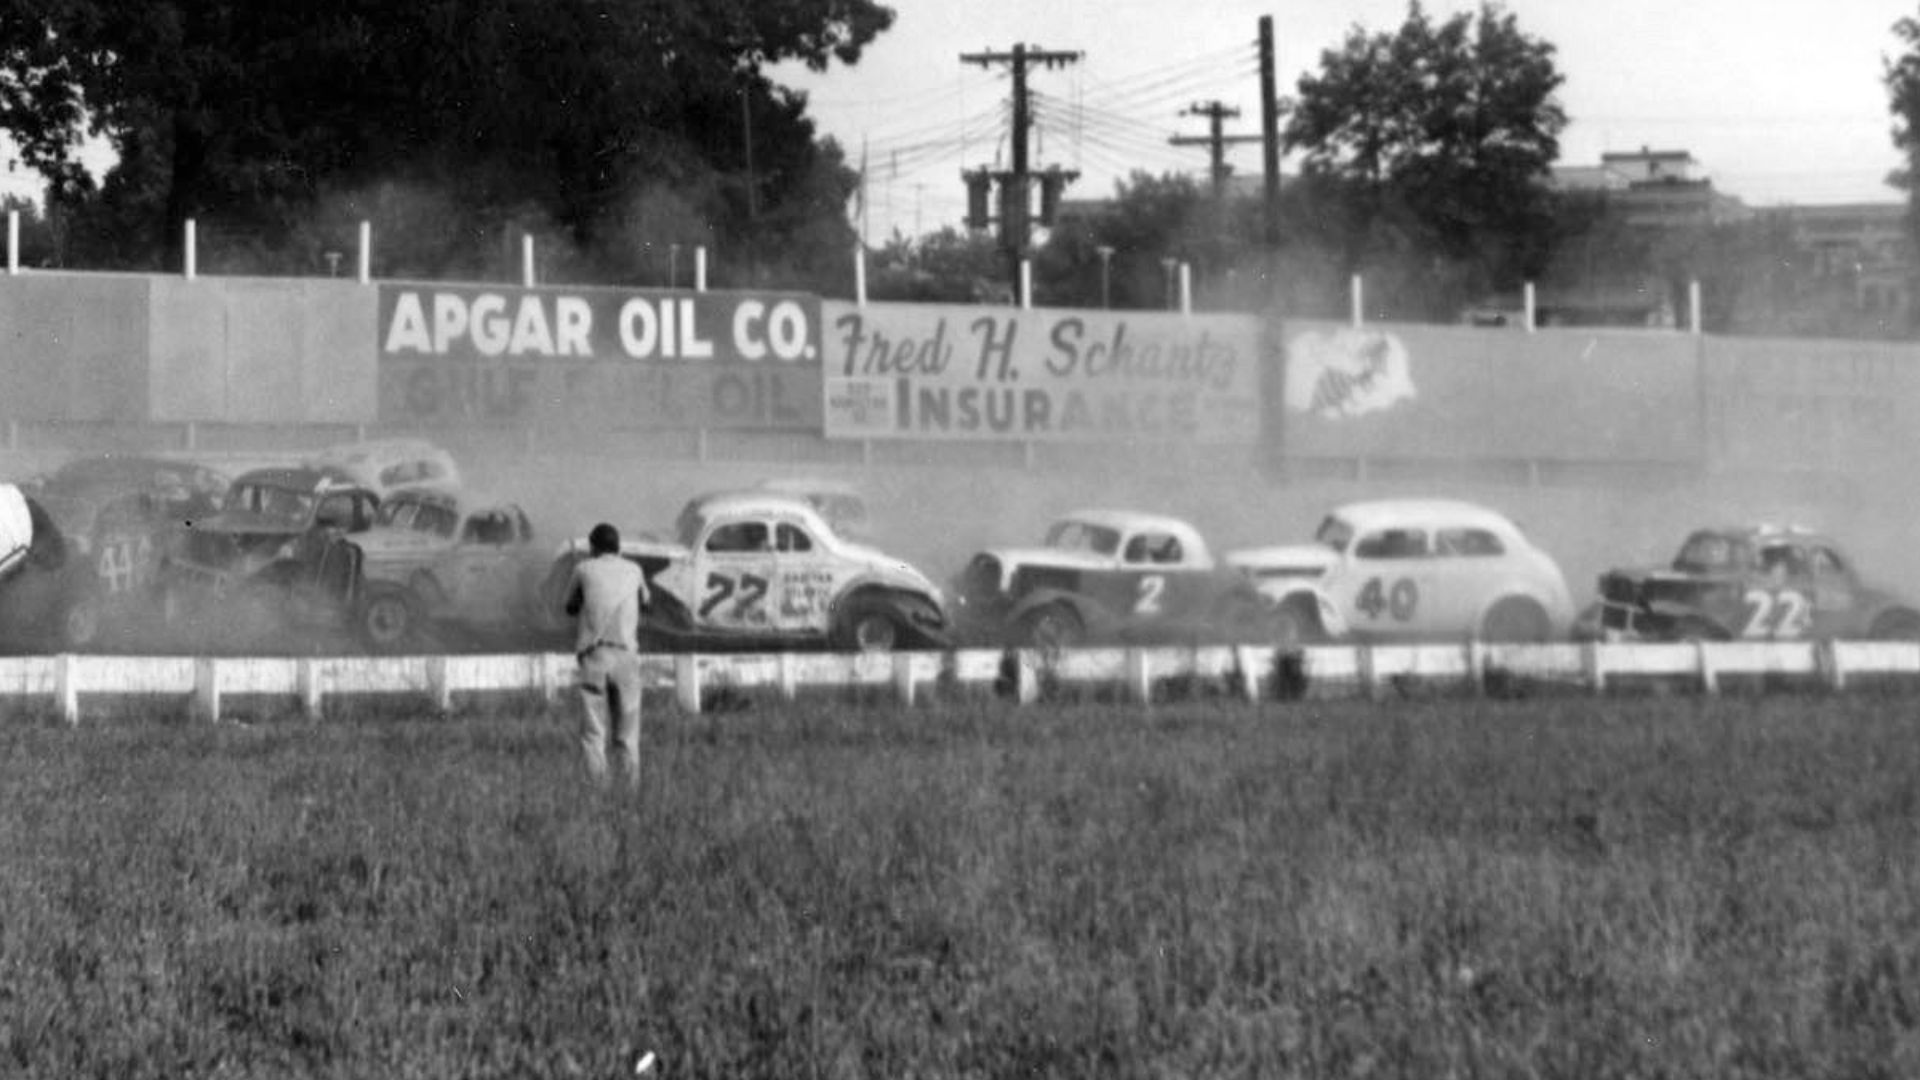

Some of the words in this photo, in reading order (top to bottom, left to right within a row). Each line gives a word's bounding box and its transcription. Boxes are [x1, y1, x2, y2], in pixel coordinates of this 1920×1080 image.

[385, 293, 594, 356] APGAR
[619, 298, 713, 358] OIL
[732, 299, 816, 360] CO.
[836, 313, 953, 377] Fred
[971, 316, 1018, 382] H.
[711, 371, 802, 420] OIL
[1135, 576, 1164, 612] 2
[1355, 577, 1418, 621] 40
[1742, 590, 1804, 636] 22
